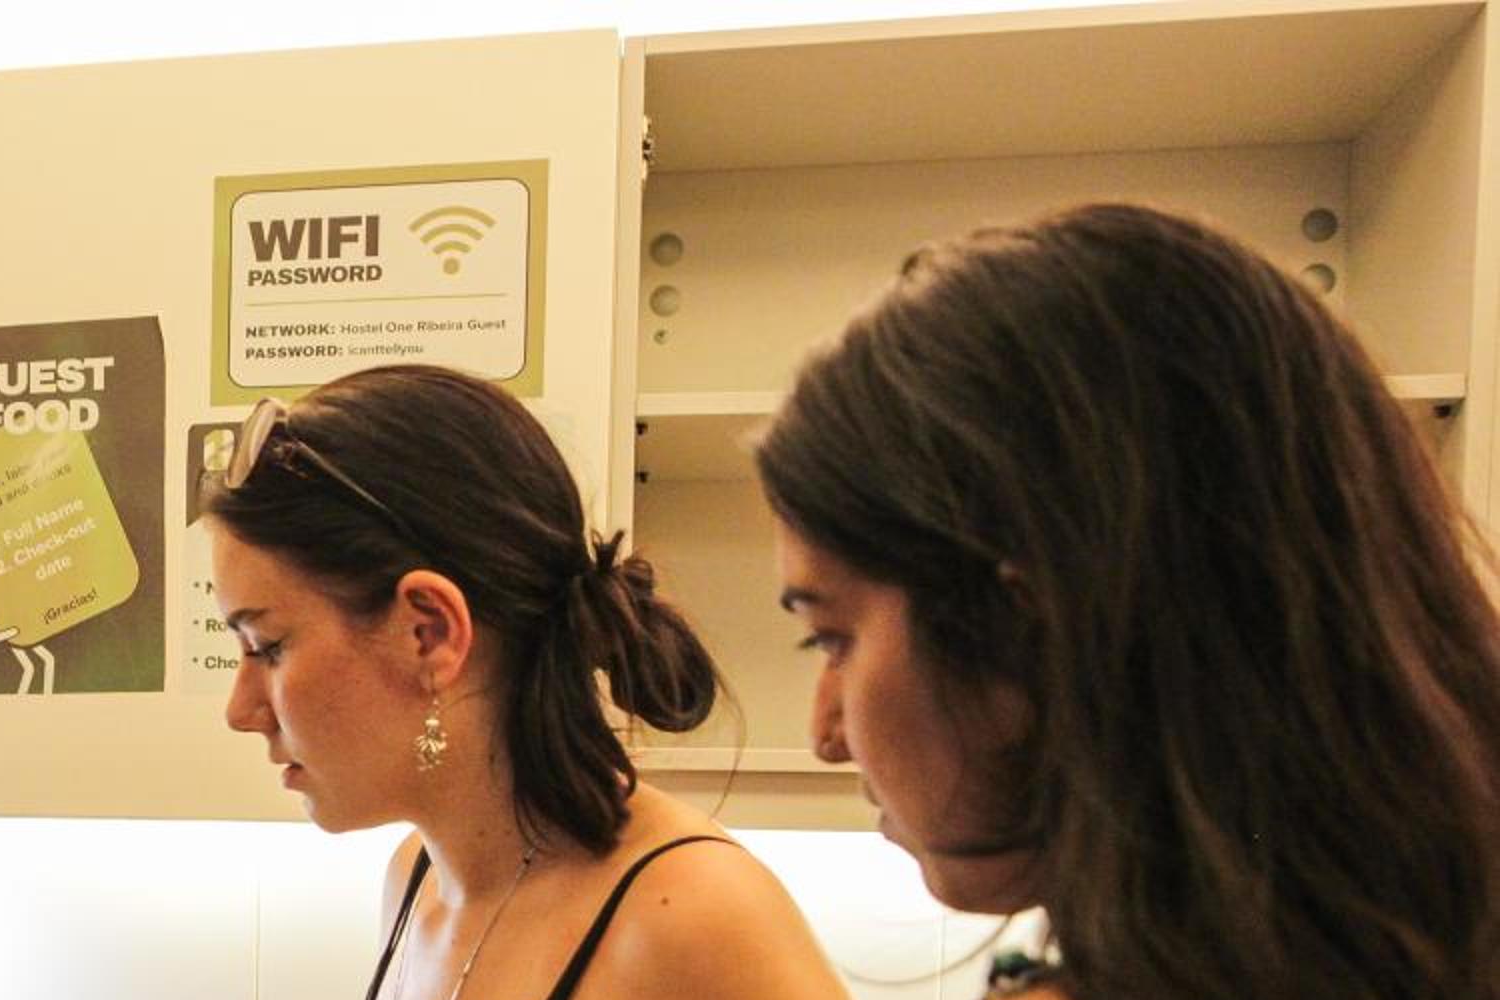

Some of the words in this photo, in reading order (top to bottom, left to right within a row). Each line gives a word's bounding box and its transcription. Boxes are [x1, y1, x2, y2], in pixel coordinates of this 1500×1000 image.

[248, 215, 379, 262] WIFI
[247, 264, 382, 287] PASSWORD
[245, 322, 336, 338] NETWORK:
[341, 322, 383, 334] Hostel
[386, 321, 414, 333] One
[417, 321, 463, 332] Ribeira
[467, 319, 506, 330] Guest
[245, 345, 343, 359] PASSWORD:
[3, 521, 33, 545] Full
[36, 499, 84, 529] Name
[14, 517, 96, 566] Check-out
[35, 555, 73, 581] date
